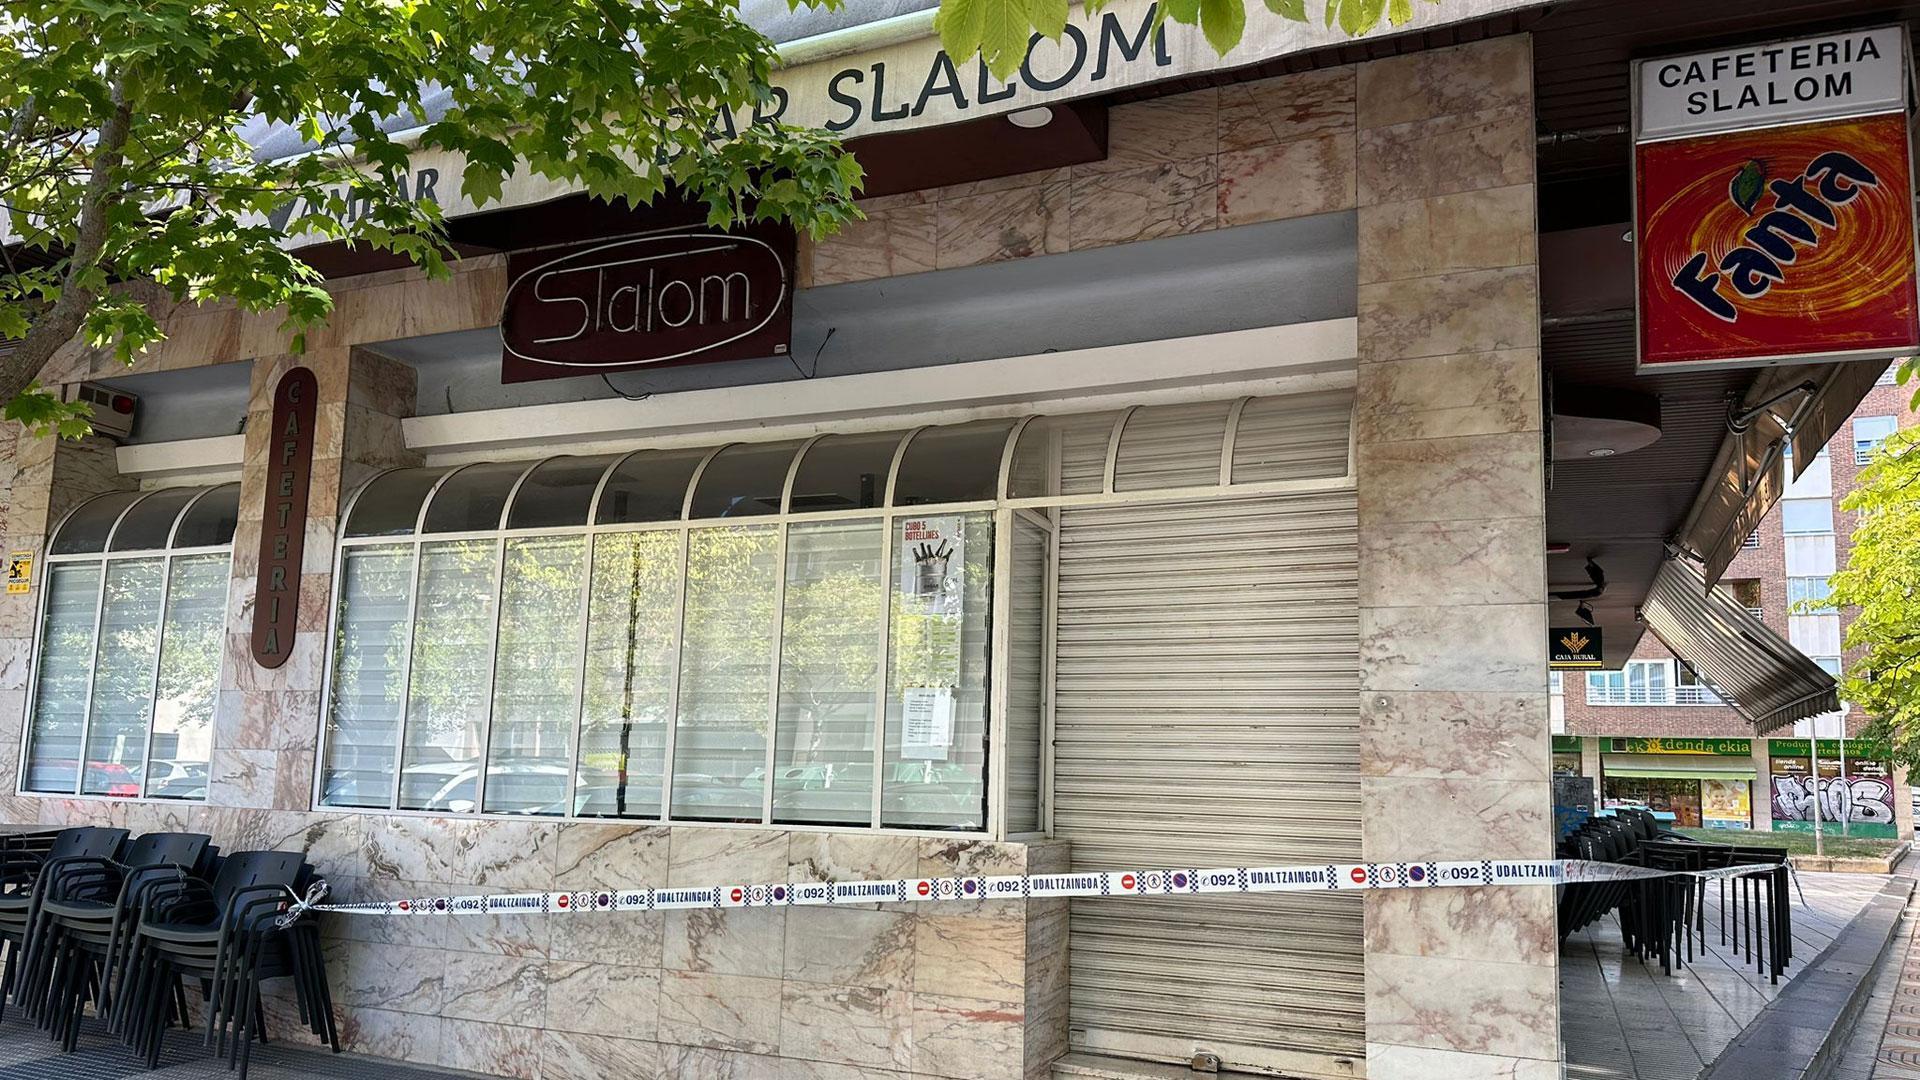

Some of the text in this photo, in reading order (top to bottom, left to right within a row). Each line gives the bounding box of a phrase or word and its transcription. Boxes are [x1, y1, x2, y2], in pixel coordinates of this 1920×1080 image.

[824, 3, 1171, 131] SLALOM
[1658, 37, 1881, 88] CAFETERIA
[1687, 71, 1852, 115] SLALOM
[1672, 151, 1878, 323] Fanta
[533, 244, 750, 343] Slalom
[261, 381, 303, 655] CAFETERIA
[1665, 739, 1714, 752] denda
[1719, 740, 1750, 752] ekia
[1210, 871, 1325, 886] 092 UDALTZAINGOA
[1451, 867, 1480, 880] 092
[803, 884, 897, 899] 092 UDALTZAINGOA
[997, 878, 1099, 892] 092 UDALTZAINGOA
[460, 899, 479, 910] 092
[626, 891, 712, 905] 092 UDALTZAINGOA
